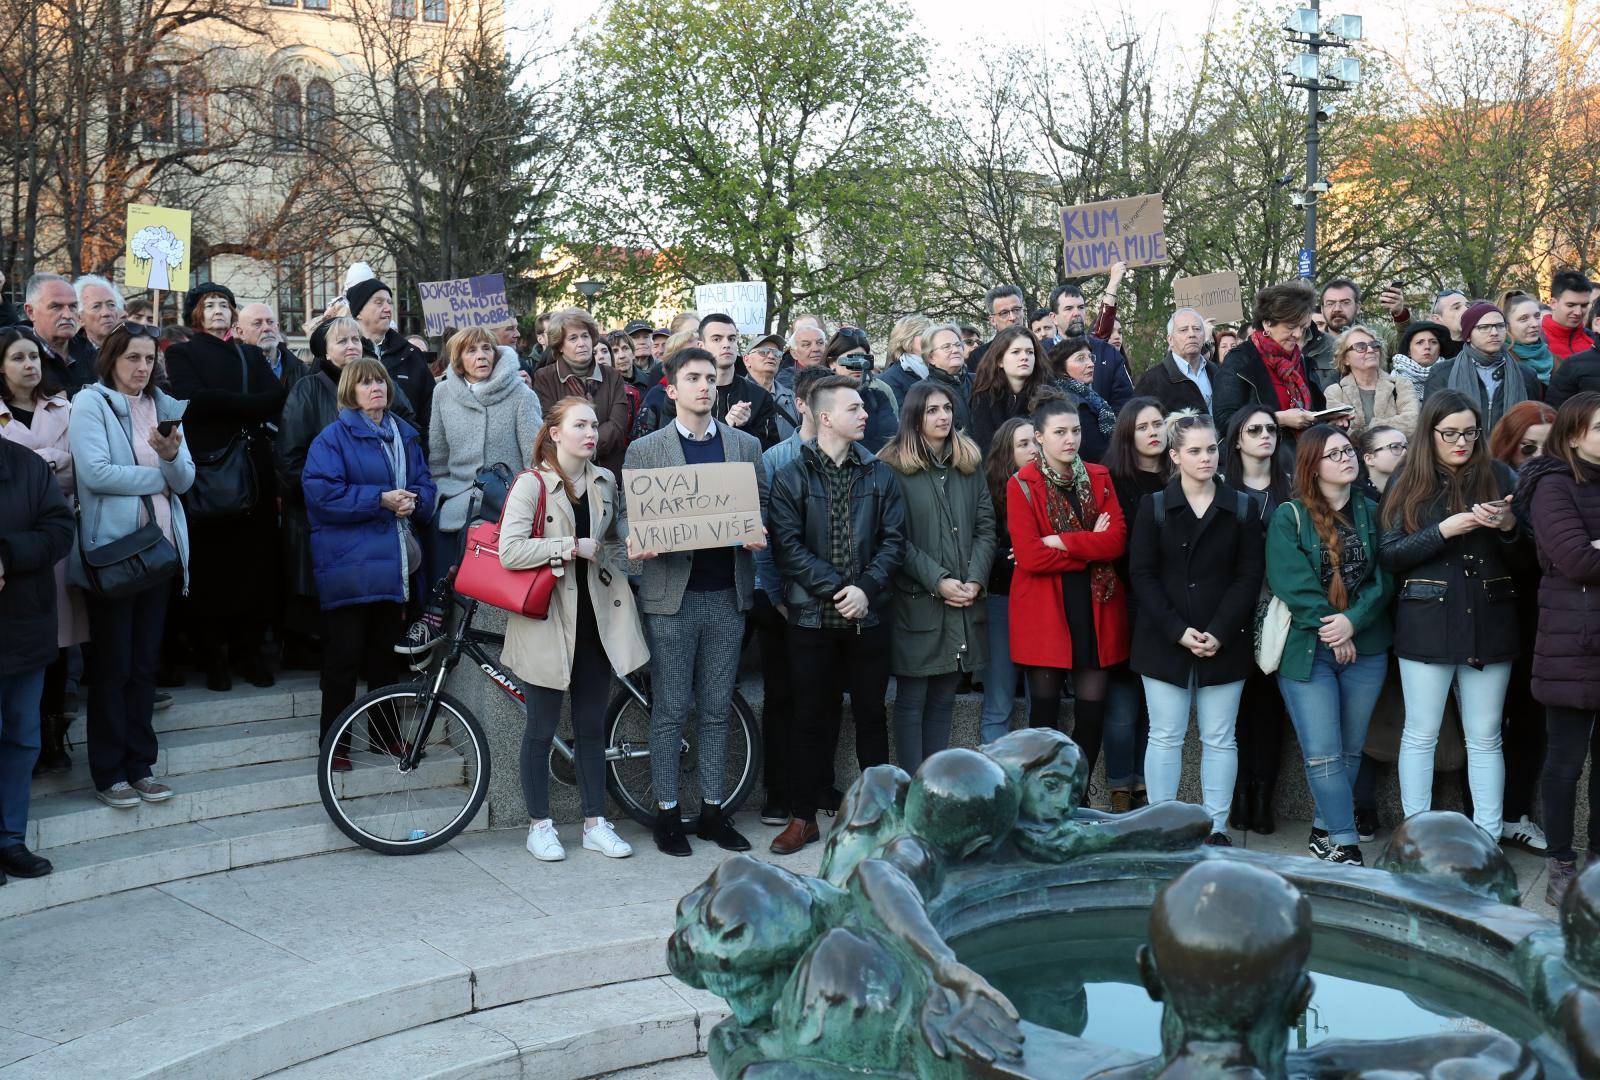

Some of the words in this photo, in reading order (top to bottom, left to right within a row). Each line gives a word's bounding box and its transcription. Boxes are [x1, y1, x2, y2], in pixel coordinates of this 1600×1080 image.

[1063, 207, 1119, 241] KUM
[1065, 241, 1121, 274] KUMA
[1123, 231, 1165, 264] MIJE
[425, 312, 450, 334] NIJE
[453, 313, 471, 328] MI
[630, 470, 699, 495] OVAJ
[640, 495, 730, 517] KARTON
[634, 523, 699, 552] VRIJEDI
[706, 514, 754, 541] VIŠE
